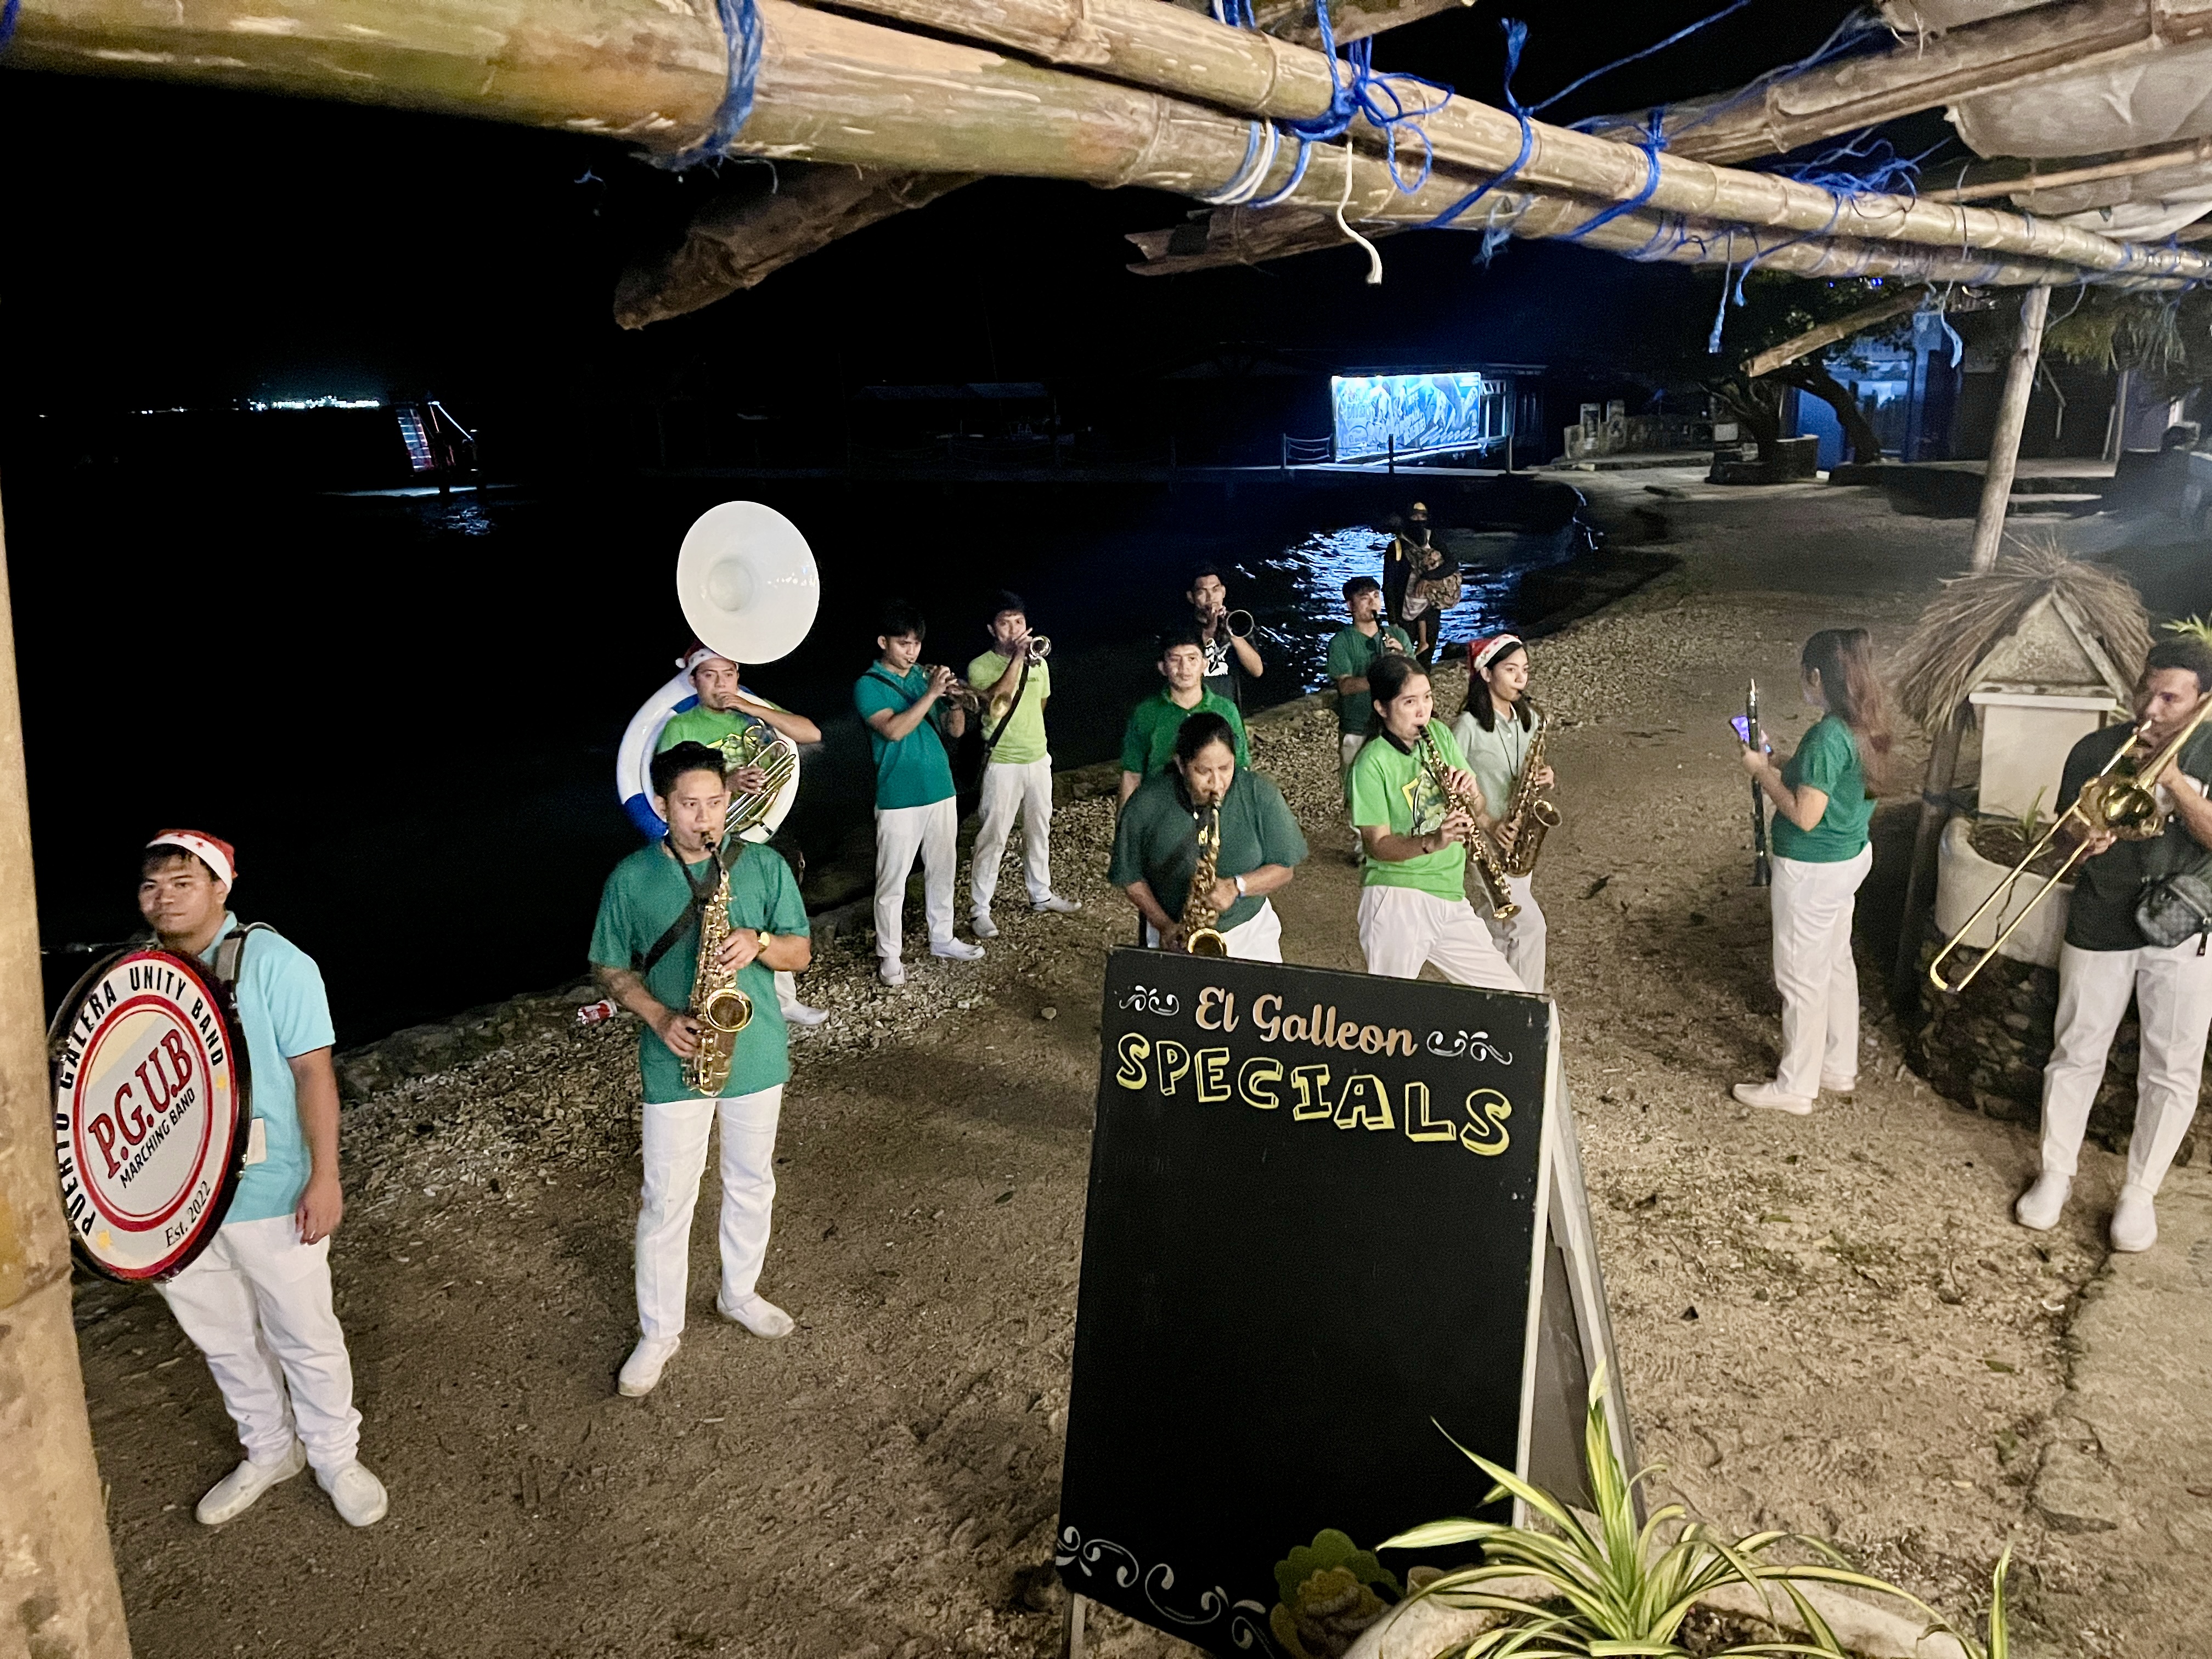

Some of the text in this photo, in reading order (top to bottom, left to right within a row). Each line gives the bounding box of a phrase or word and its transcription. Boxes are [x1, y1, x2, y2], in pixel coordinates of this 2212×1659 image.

[60, 980, 117, 1090] GALERA
[130, 966, 187, 1001] UNITY
[191, 996, 224, 1066] BAND
[1195, 986, 1419, 1057] El Galleon
[120, 1087, 195, 1189] MARCHING BAND
[1116, 1032, 1513, 1156] SPECIALS
[165, 1180, 211, 1248] Est. 2022
